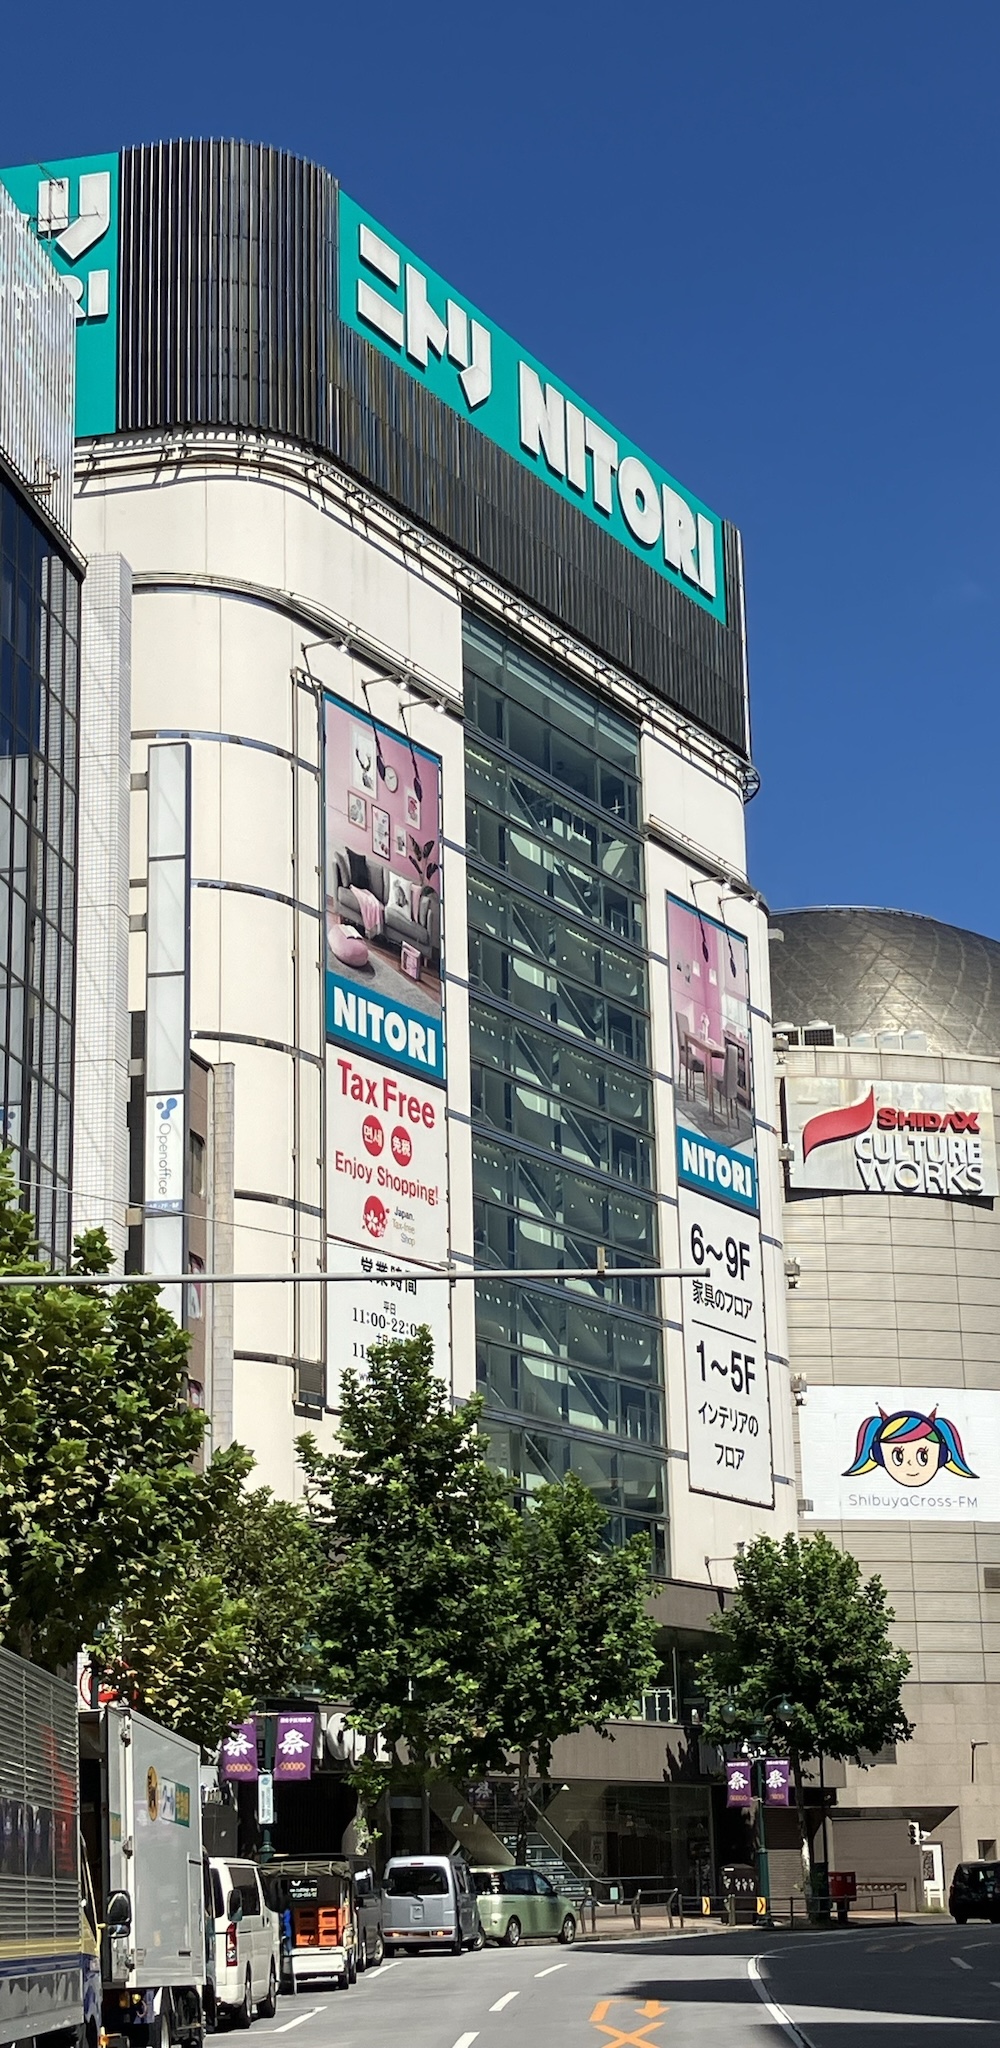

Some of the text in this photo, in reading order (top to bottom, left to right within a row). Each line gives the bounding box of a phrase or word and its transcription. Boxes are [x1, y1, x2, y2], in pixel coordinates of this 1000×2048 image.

[357, 223, 716, 598] ニトリ NITORI
[334, 986, 436, 1067] NITORI
[337, 1058, 435, 1128] Tax Free
[877, 1107, 981, 1134] SHIDAX
[157, 1123, 172, 1195] Openoffice
[854, 1133, 983, 1164] CULTURE
[335, 1150, 438, 1206] Enjoy Shopping!
[682, 1137, 752, 1198] NITORI
[856, 1159, 986, 1195] WORKS
[692, 1279, 752, 1319] 家具のフロア
[353, 1307, 417, 1338] 11:00-22:0
[698, 1401, 759, 1437] インテリアの
[714, 1443, 745, 1470] フロア
[849, 1494, 978, 1509] ShibuyaCross-FM
[278, 1729, 310, 1756] 祭
